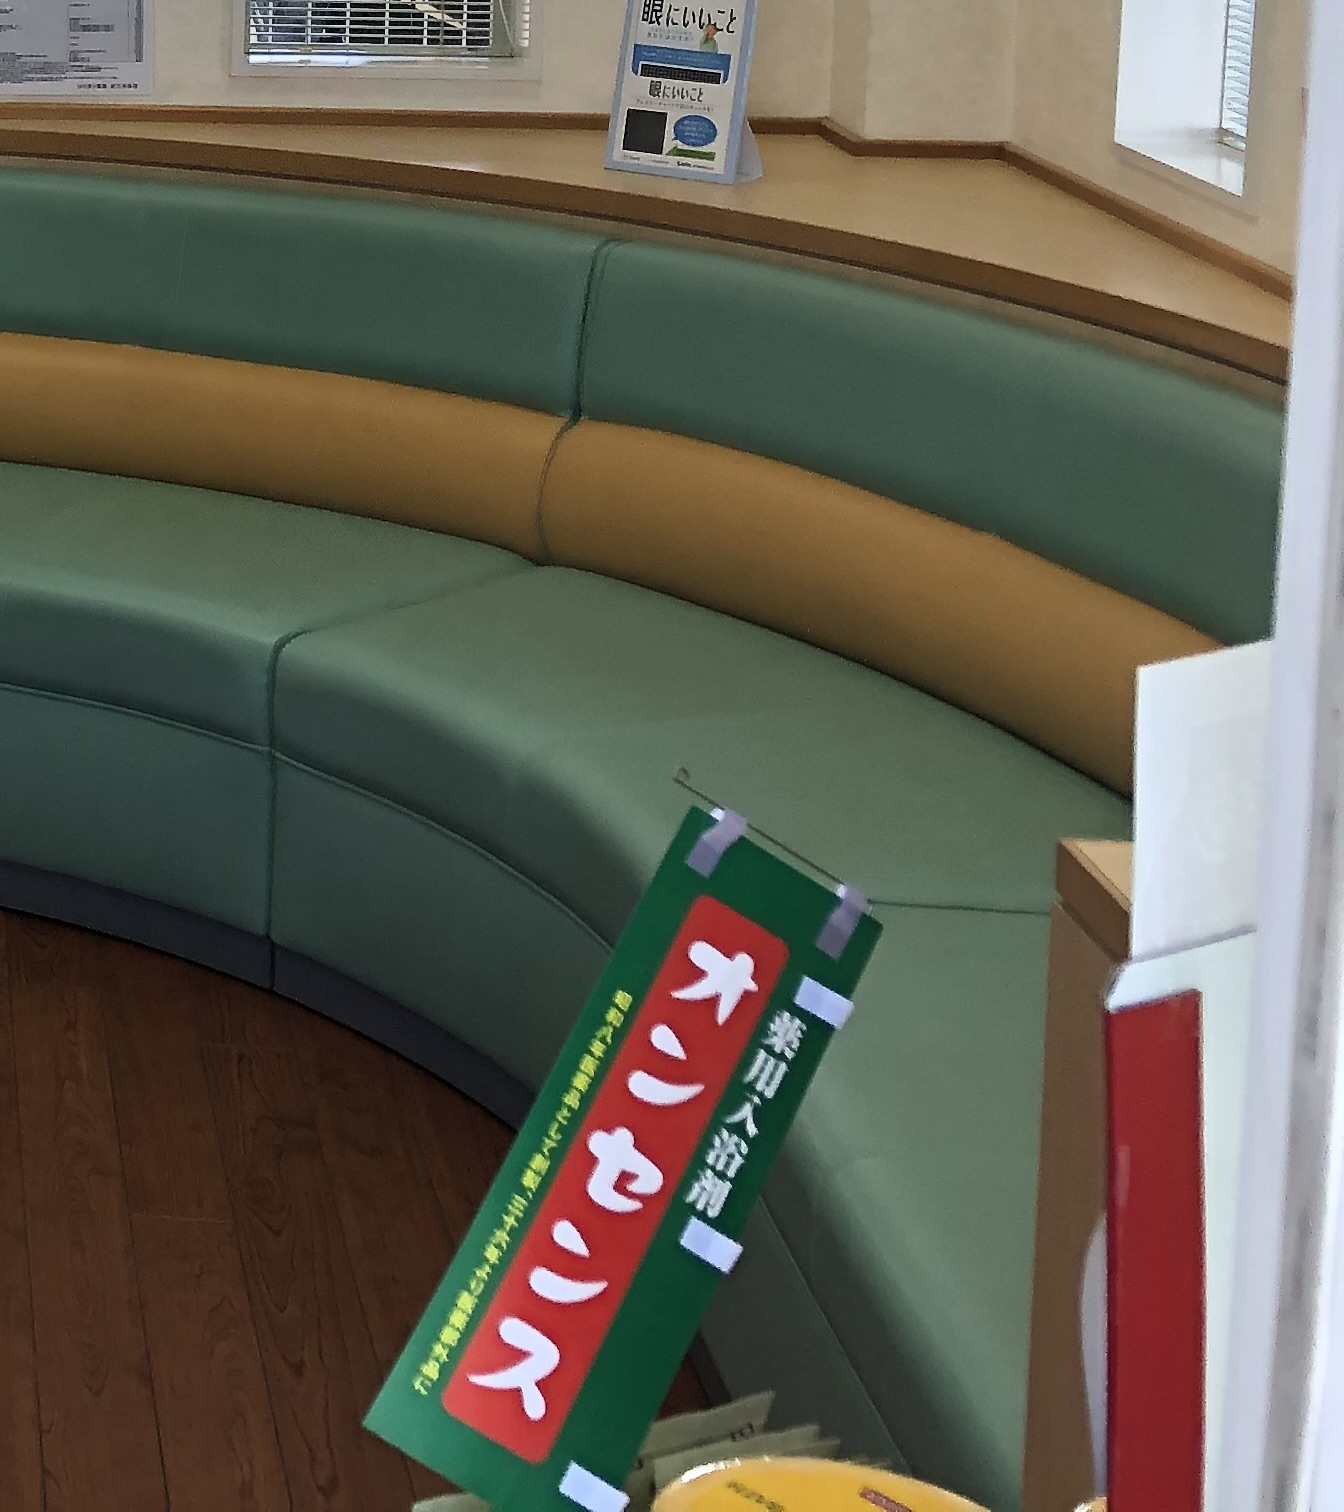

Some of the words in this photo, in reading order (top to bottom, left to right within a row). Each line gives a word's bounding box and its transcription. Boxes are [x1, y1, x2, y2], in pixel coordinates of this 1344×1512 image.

[467, 938, 759, 1421] オンセンス
[686, 1009, 809, 1219] 薬用入浴剤
